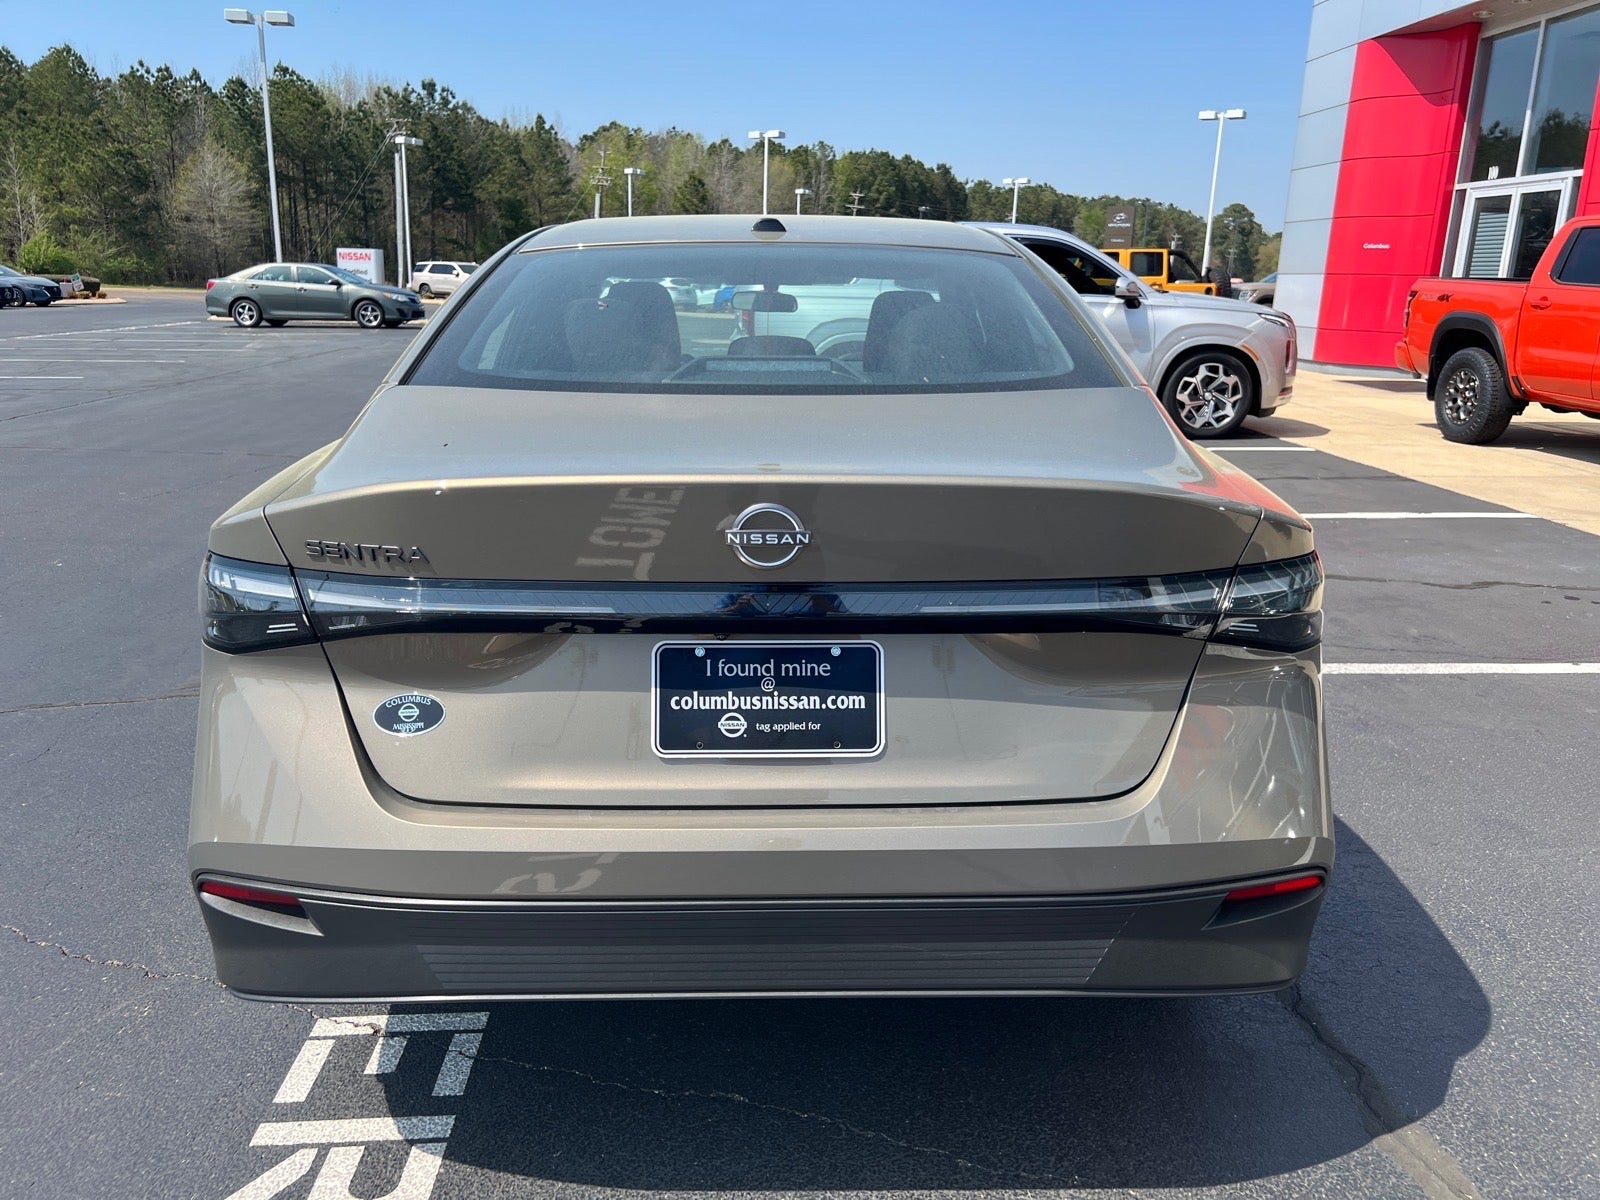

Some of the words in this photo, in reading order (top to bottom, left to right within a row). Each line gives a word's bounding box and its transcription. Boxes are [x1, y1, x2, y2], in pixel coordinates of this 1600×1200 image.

[338, 252, 371, 261] NISSAN
[727, 533, 809, 544] NISSAN
[305, 539, 431, 565] SENTRA
[706, 659, 711, 677] I
[718, 658, 774, 677] found
[781, 659, 831, 677] mine
[760, 677, 776, 692] @
[386, 696, 431, 708] COLUMBUS
[670, 691, 866, 710] columbusnissan.com
[756, 722, 771, 732] tag
[772, 721, 806, 732] applied
[808, 721, 821, 730] for
